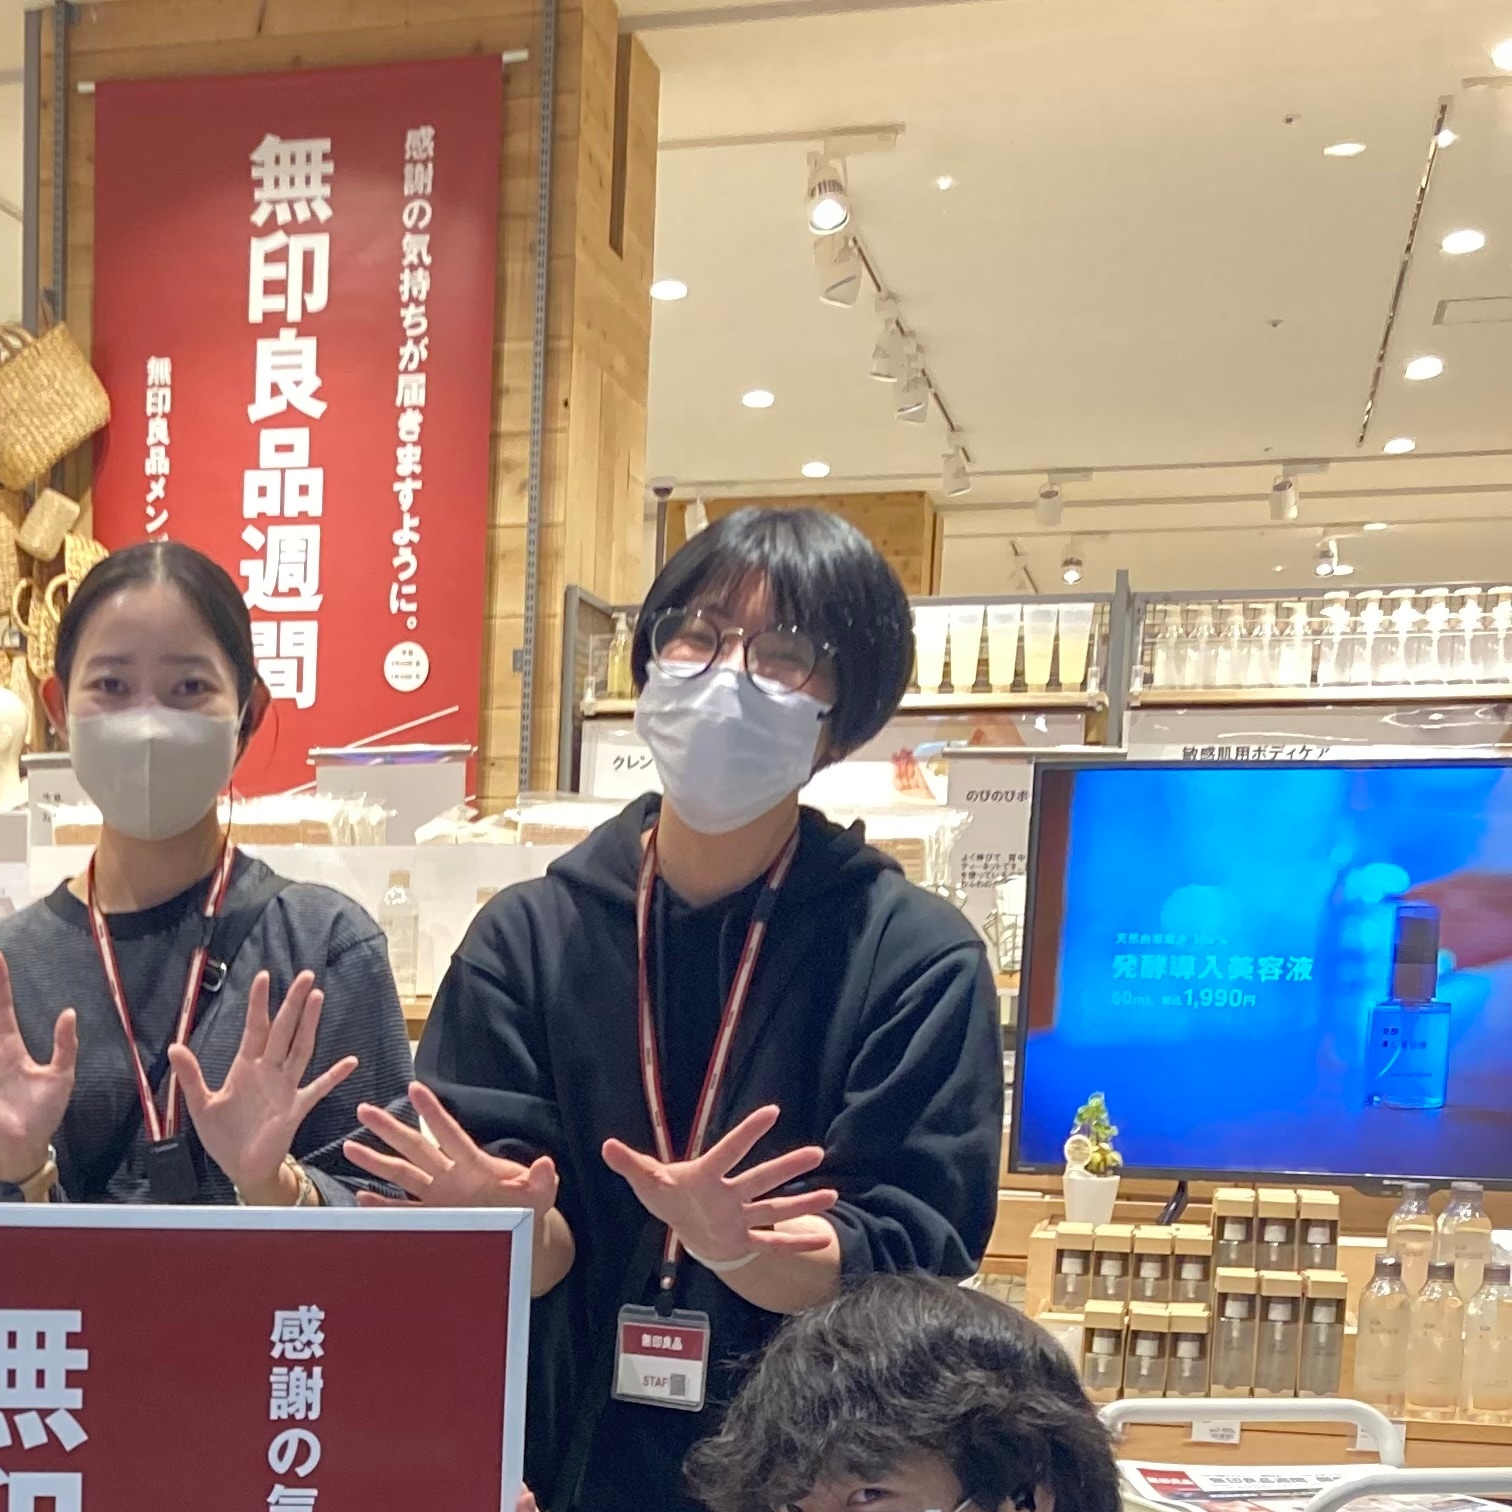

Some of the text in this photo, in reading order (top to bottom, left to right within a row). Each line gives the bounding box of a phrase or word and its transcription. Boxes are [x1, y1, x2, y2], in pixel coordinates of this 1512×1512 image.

[144, 355, 172, 542] 無印良品メン
[240, 134, 335, 710] 無印良品週間
[388, 126, 436, 630] 感謝の気持ちが届きますように。
[1112, 954, 1314, 983] 発酵導入美容液
